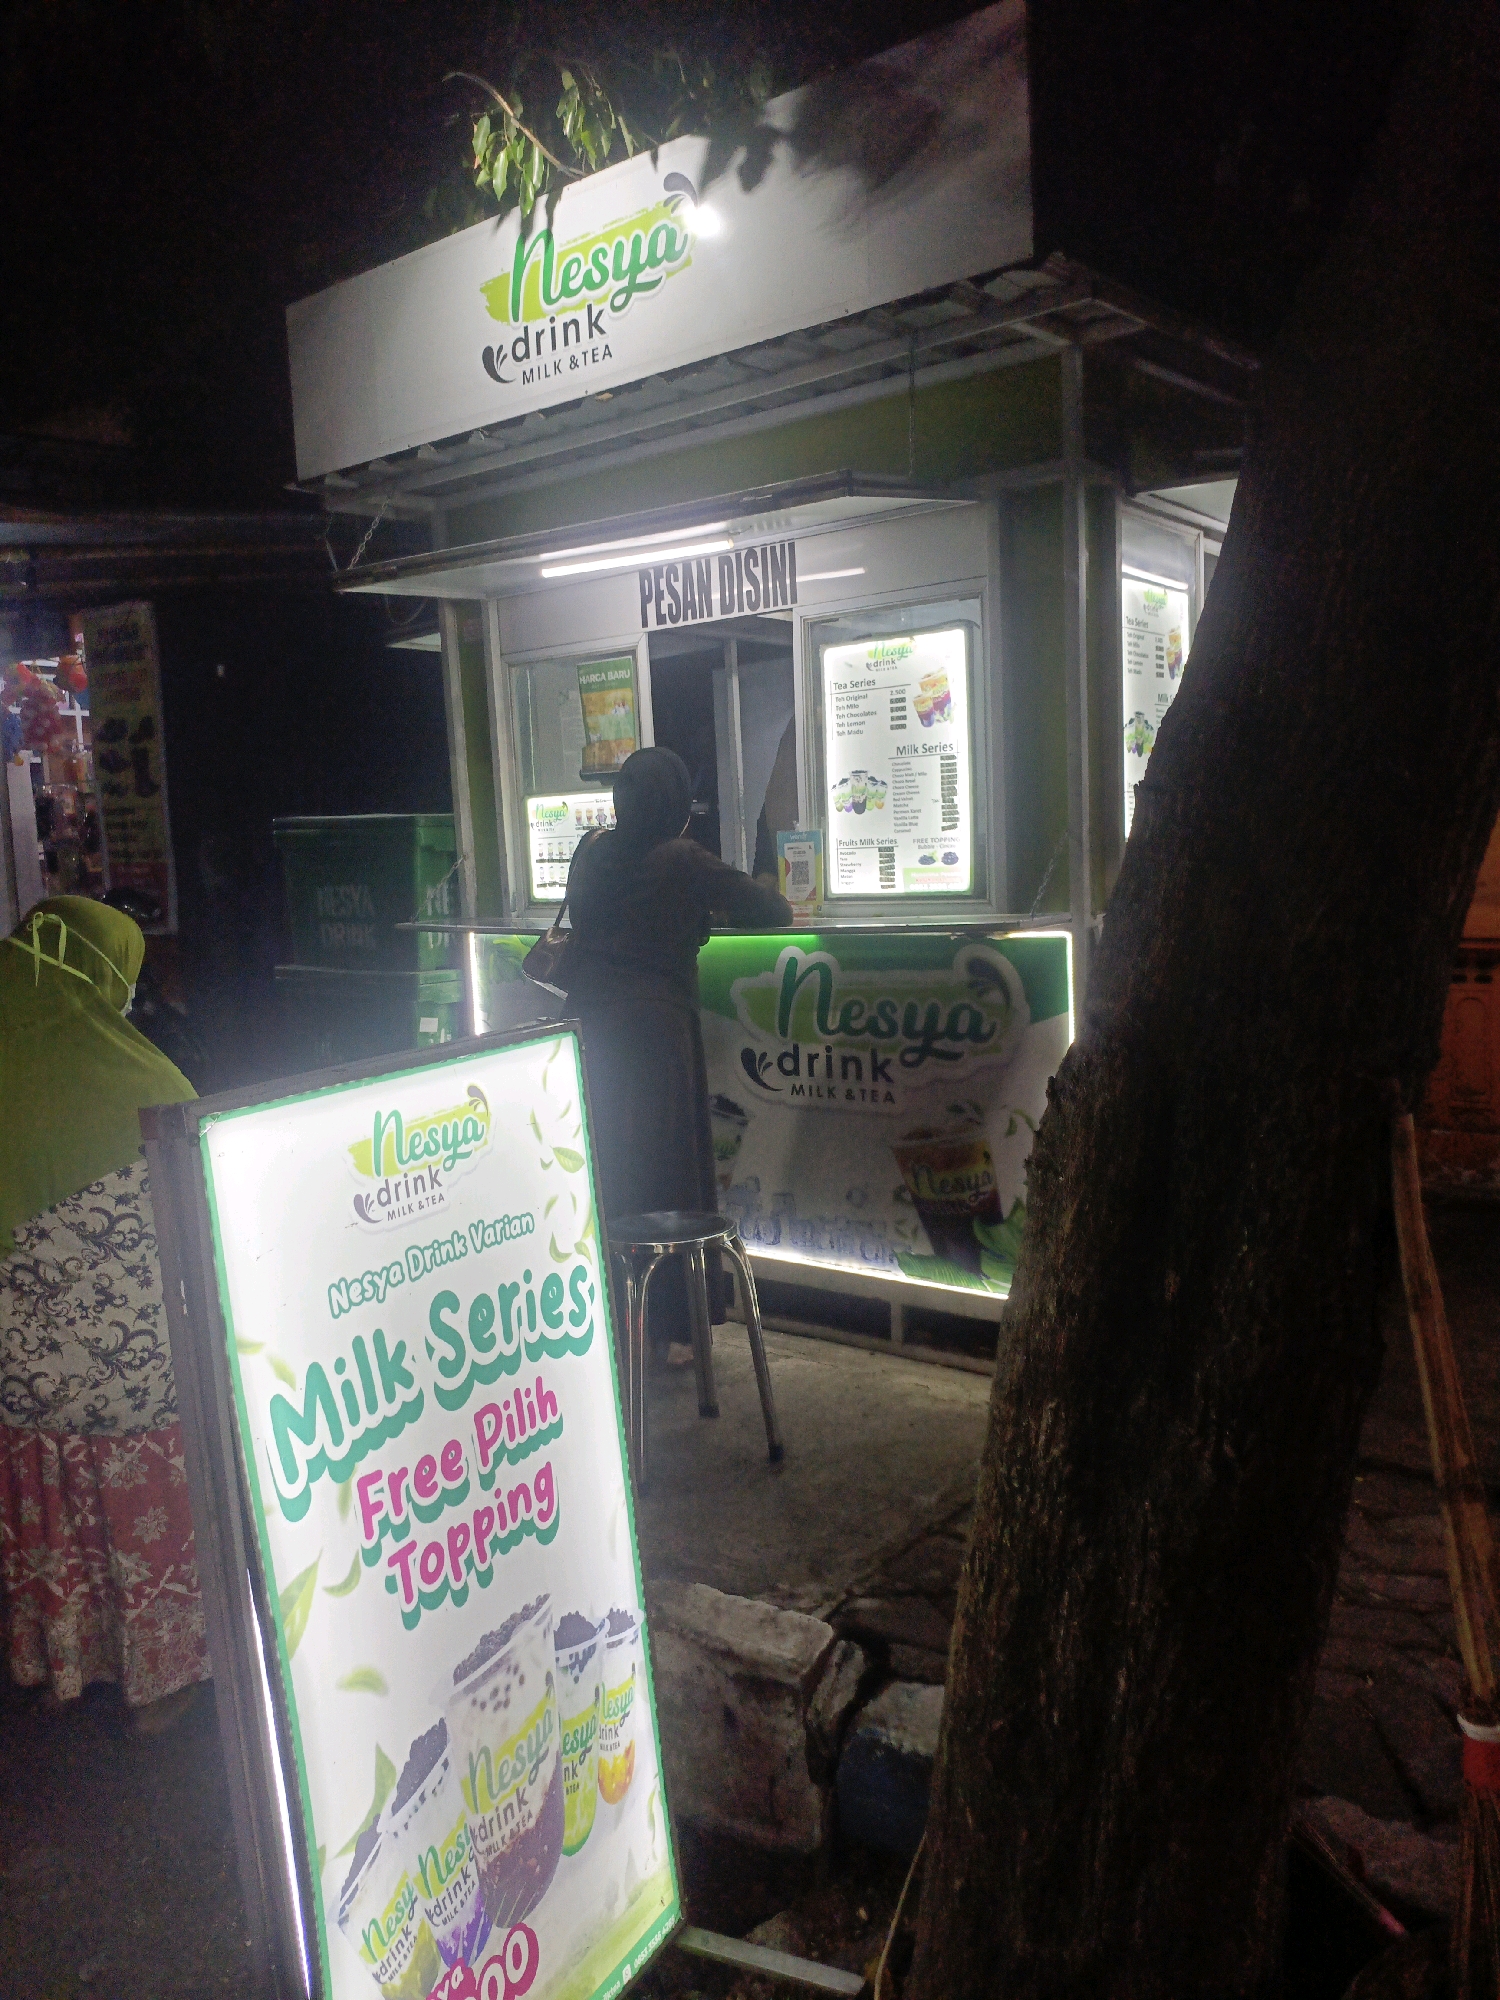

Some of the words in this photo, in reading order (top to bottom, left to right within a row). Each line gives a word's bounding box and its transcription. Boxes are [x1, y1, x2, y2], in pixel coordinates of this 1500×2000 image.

[512, 223, 688, 322] Nesya
[511, 303, 607, 363] drink
[522, 358, 563, 385] MILK
[638, 558, 714, 628] PESAN
[718, 541, 798, 616] DISINI
[579, 671, 607, 685] HARGA
[607, 668, 631, 680] BARU
[832, 682, 848, 690] Tea
[849, 678, 876, 688] Series
[873, 658, 896, 668] drink
[846, 693, 868, 701] Original
[896, 746, 919, 757] Milk
[921, 743, 954, 753] Series
[838, 838, 858, 847] Fruits
[859, 838, 875, 846] Milk
[876, 837, 898, 845] Series
[778, 956, 997, 1068] Nesya
[776, 1043, 895, 1084] drink
[790, 1083, 837, 1099] MILK
[373, 1109, 485, 1178] Nesya
[376, 1164, 443, 1207] drink
[387, 1203, 415, 1222] MILK
[327, 1260, 406, 1320] Nesya
[405, 1229, 469, 1282] Drink
[469, 1211, 536, 1254] Varian
[268, 1328, 418, 1500] Milk
[428, 1264, 590, 1385] Series
[355, 1438, 464, 1544] Free
[473, 1375, 559, 1470] Pilih
[386, 1460, 557, 1608] Topping
[468, 1708, 554, 1814] Nesya
[561, 1714, 597, 1766] esya
[478, 1786, 529, 1843] drink
[432, 1864, 472, 1918] drink
[379, 1923, 413, 1979] drink
